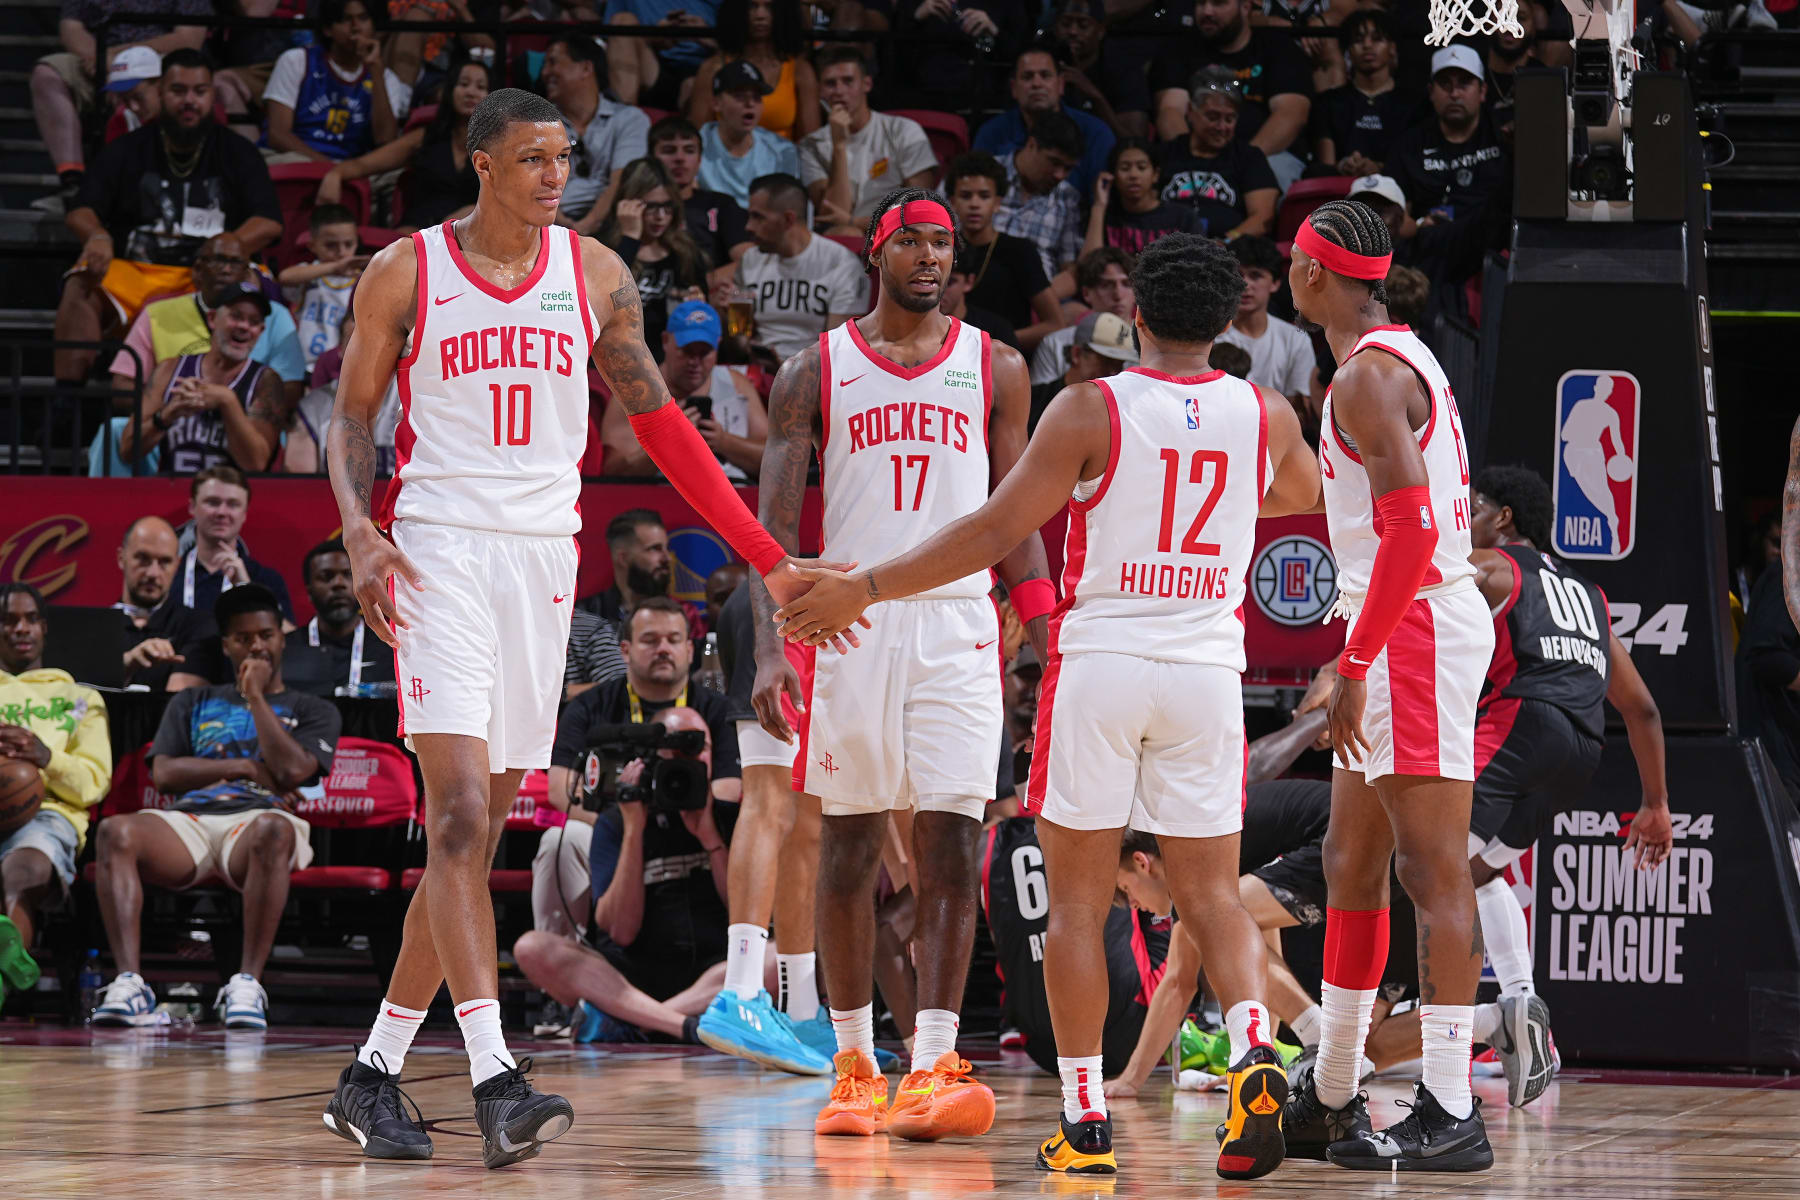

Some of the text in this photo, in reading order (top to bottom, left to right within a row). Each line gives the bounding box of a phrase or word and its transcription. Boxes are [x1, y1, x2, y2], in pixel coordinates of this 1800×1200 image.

[540, 301, 574, 312] karma
[541, 290, 573, 301] credit
[439, 325, 574, 382] ROCKETS
[946, 369, 977, 381] credit
[944, 377, 977, 390] karma
[488, 383, 532, 447] 10
[848, 402, 970, 455] ROCKETS
[890, 454, 931, 512] 17
[1157, 447, 1229, 557] 12
[1563, 515, 1603, 547] NBA
[1119, 562, 1229, 600] HUDGINS
[1538, 568, 1600, 641] 00
[1551, 843, 1714, 916] SUMMER
[1549, 913, 1686, 985] LEAGUE
